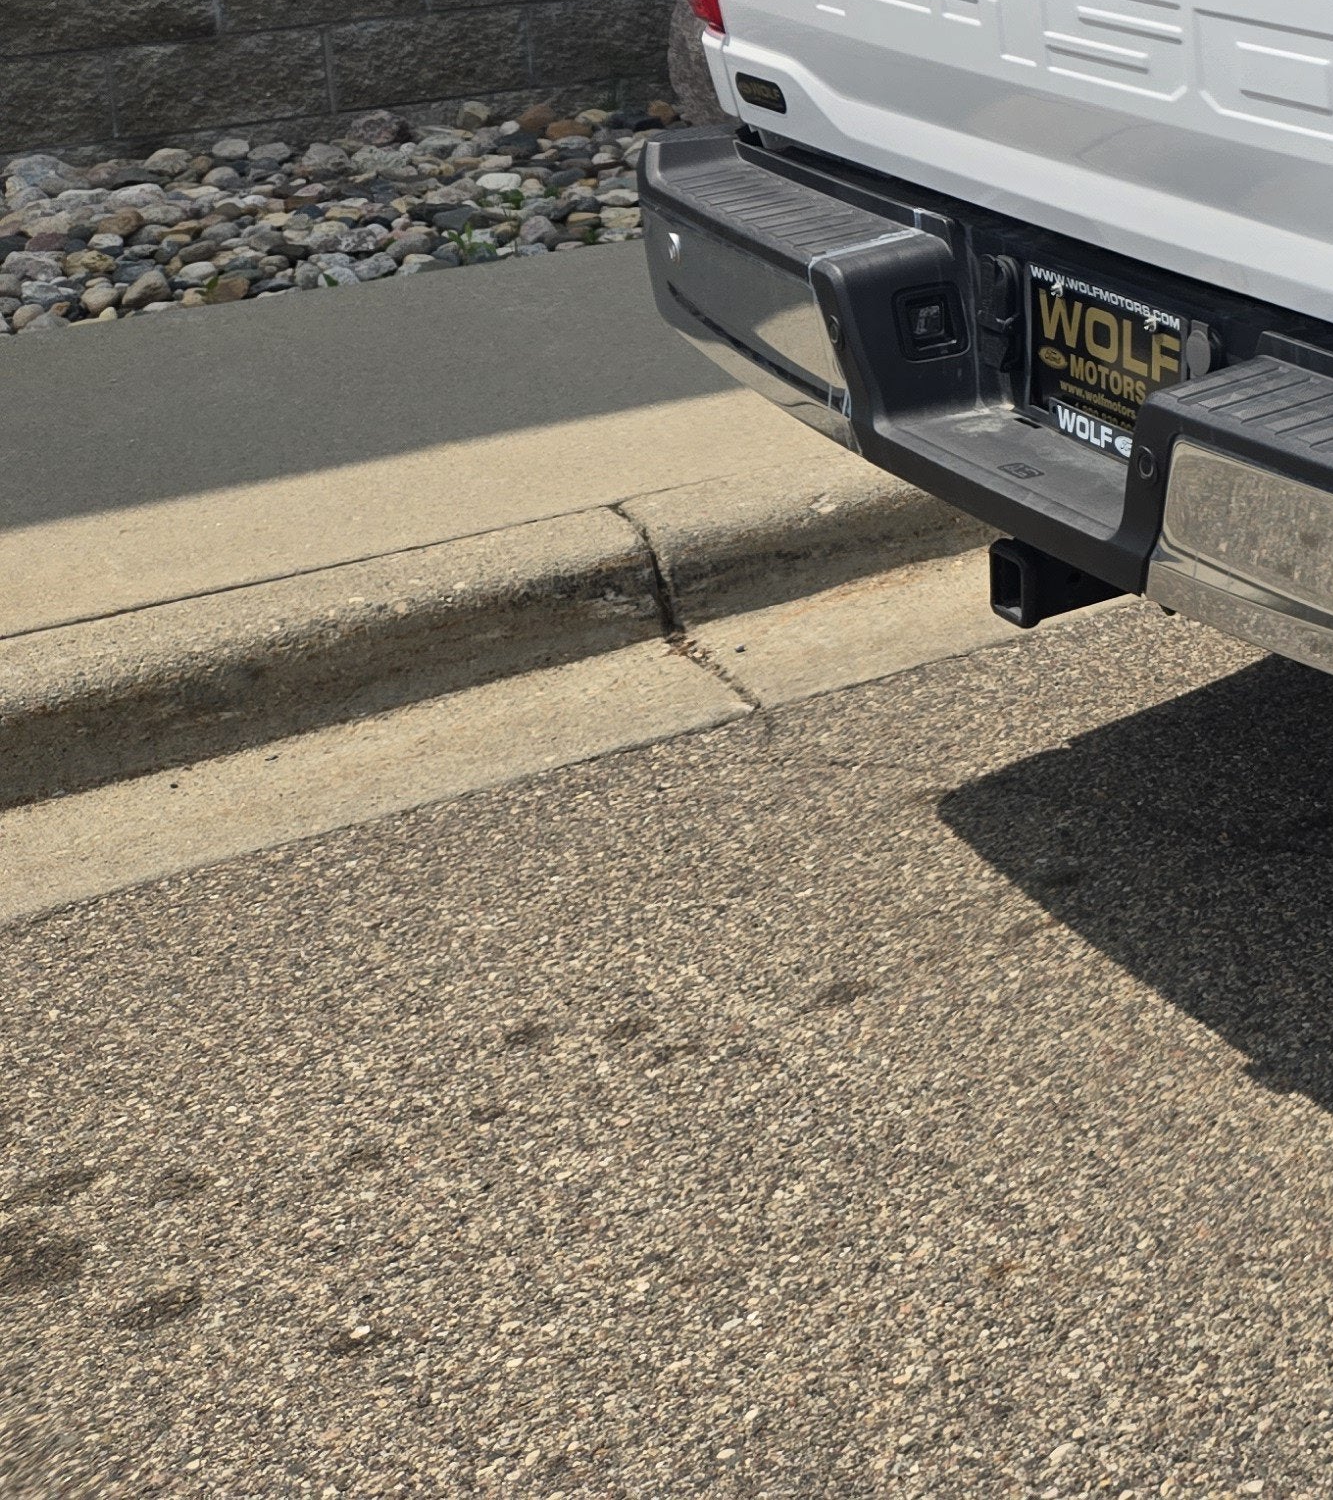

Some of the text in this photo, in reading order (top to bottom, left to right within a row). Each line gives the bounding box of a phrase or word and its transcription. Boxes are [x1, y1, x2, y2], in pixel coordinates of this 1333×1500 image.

[1038, 287, 1182, 383] WOLF
[1069, 354, 1147, 405] MOTORS
[1056, 404, 1114, 449] WOLF
